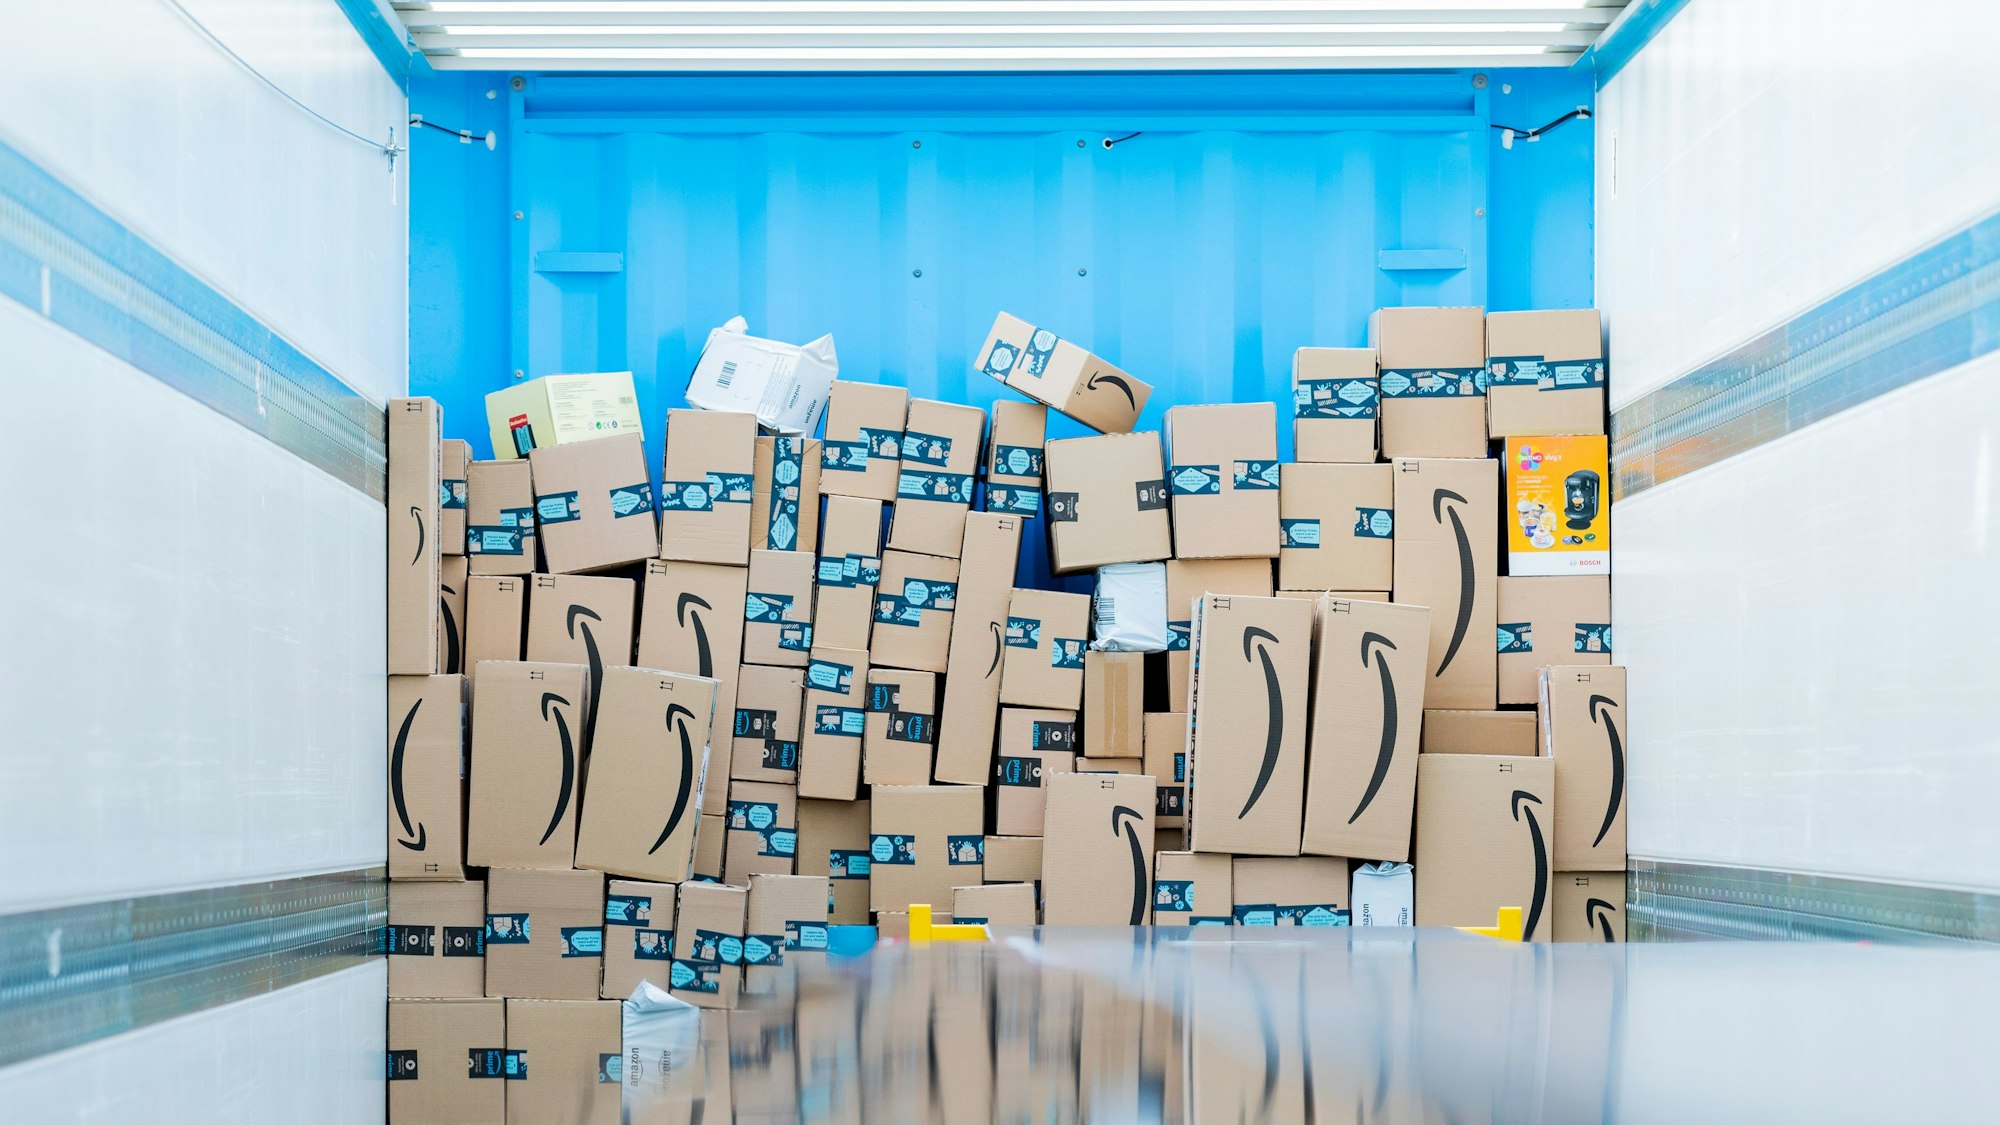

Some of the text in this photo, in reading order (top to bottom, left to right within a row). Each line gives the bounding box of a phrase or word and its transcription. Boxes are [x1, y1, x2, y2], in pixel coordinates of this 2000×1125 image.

[804, 399, 818, 424] amazon
[872, 686, 881, 710] prime
[735, 711, 743, 735] prime
[914, 716, 924, 740] prime
[1033, 724, 1041, 748] prime
[781, 743, 790, 767] prime
[1012, 759, 1021, 783] prime
[1176, 756, 1185, 780] prime
[389, 928, 398, 952] prime
[475, 930, 484, 954] prime
[486, 1051, 495, 1076] prime
[630, 1047, 639, 1087] amazon
